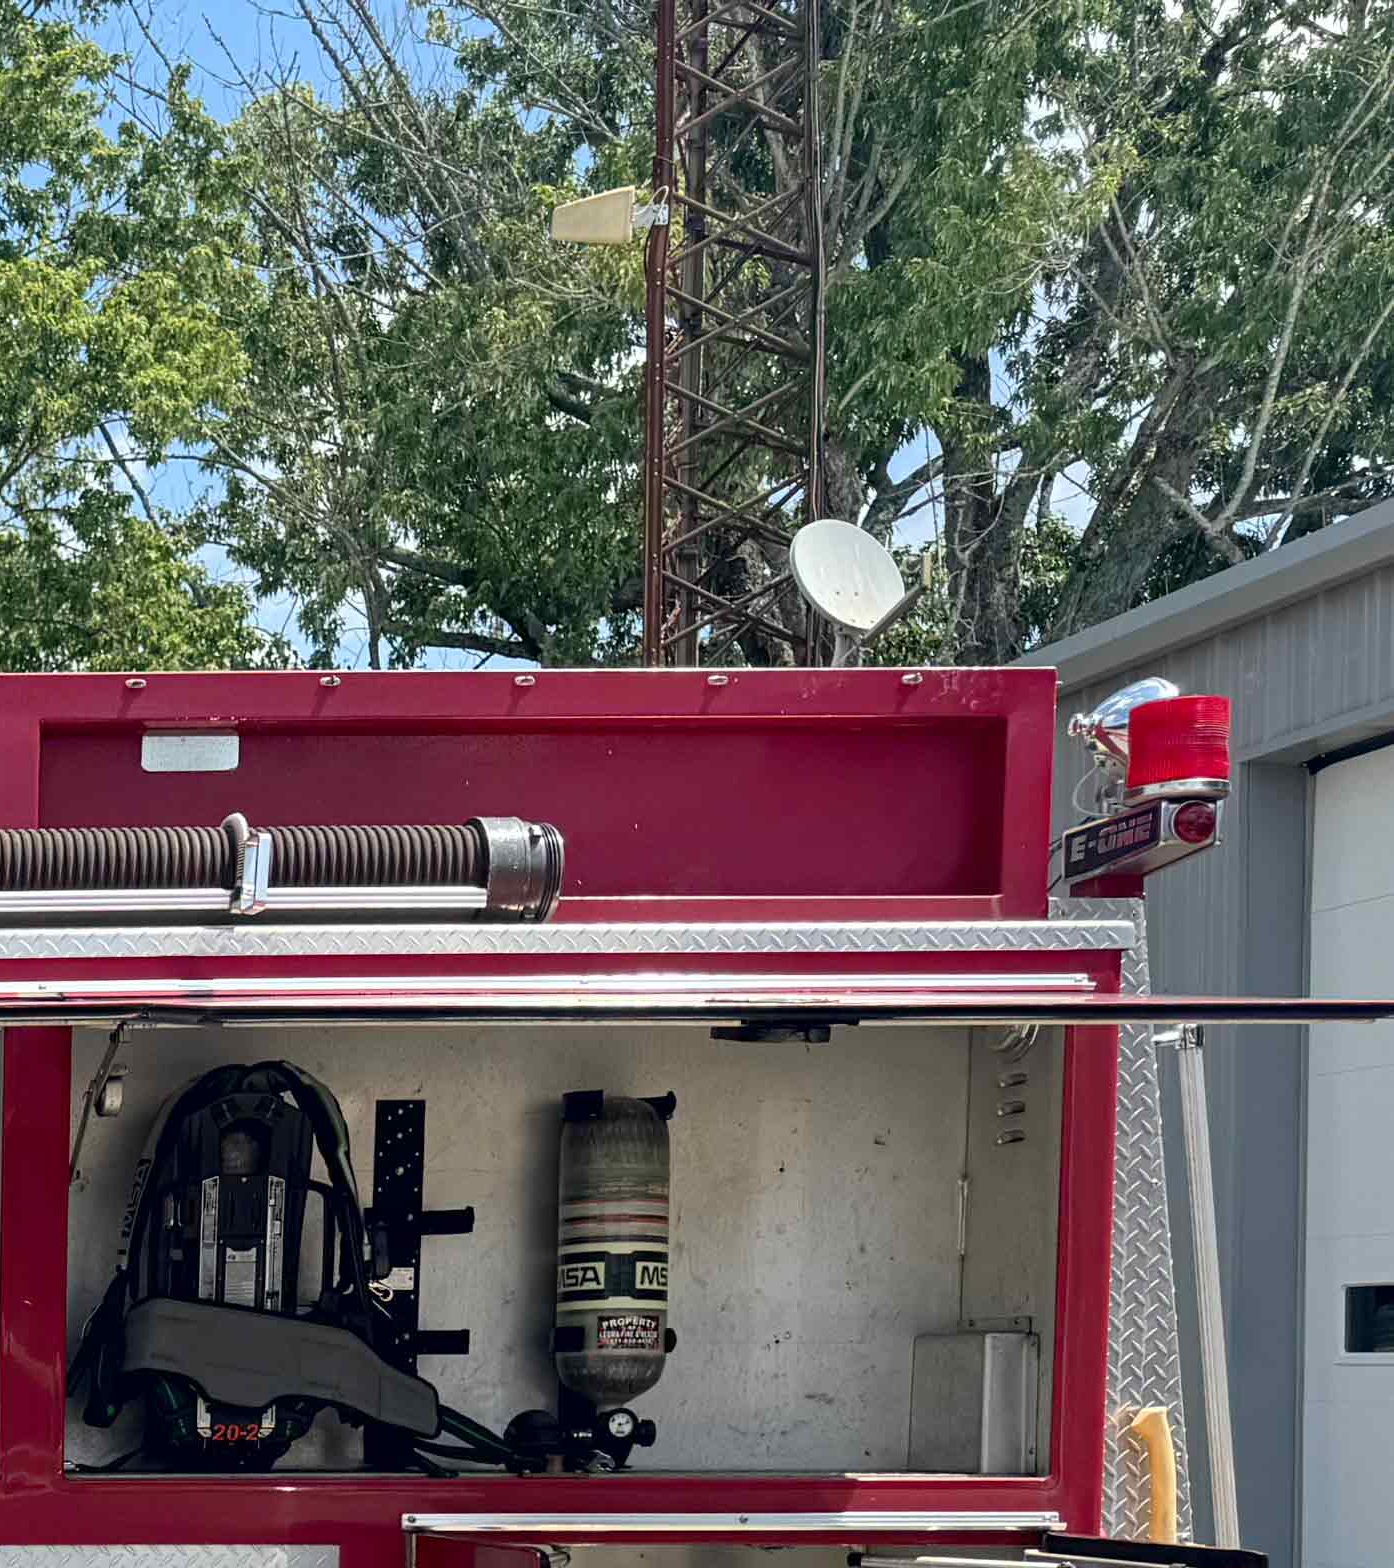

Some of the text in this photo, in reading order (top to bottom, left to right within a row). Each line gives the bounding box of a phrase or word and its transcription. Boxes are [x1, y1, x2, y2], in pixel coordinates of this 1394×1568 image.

[1070, 812, 1153, 862] E-ONE
[601, 1315, 657, 1329] PROPERTY
[213, 1423, 259, 1441] 20-2
